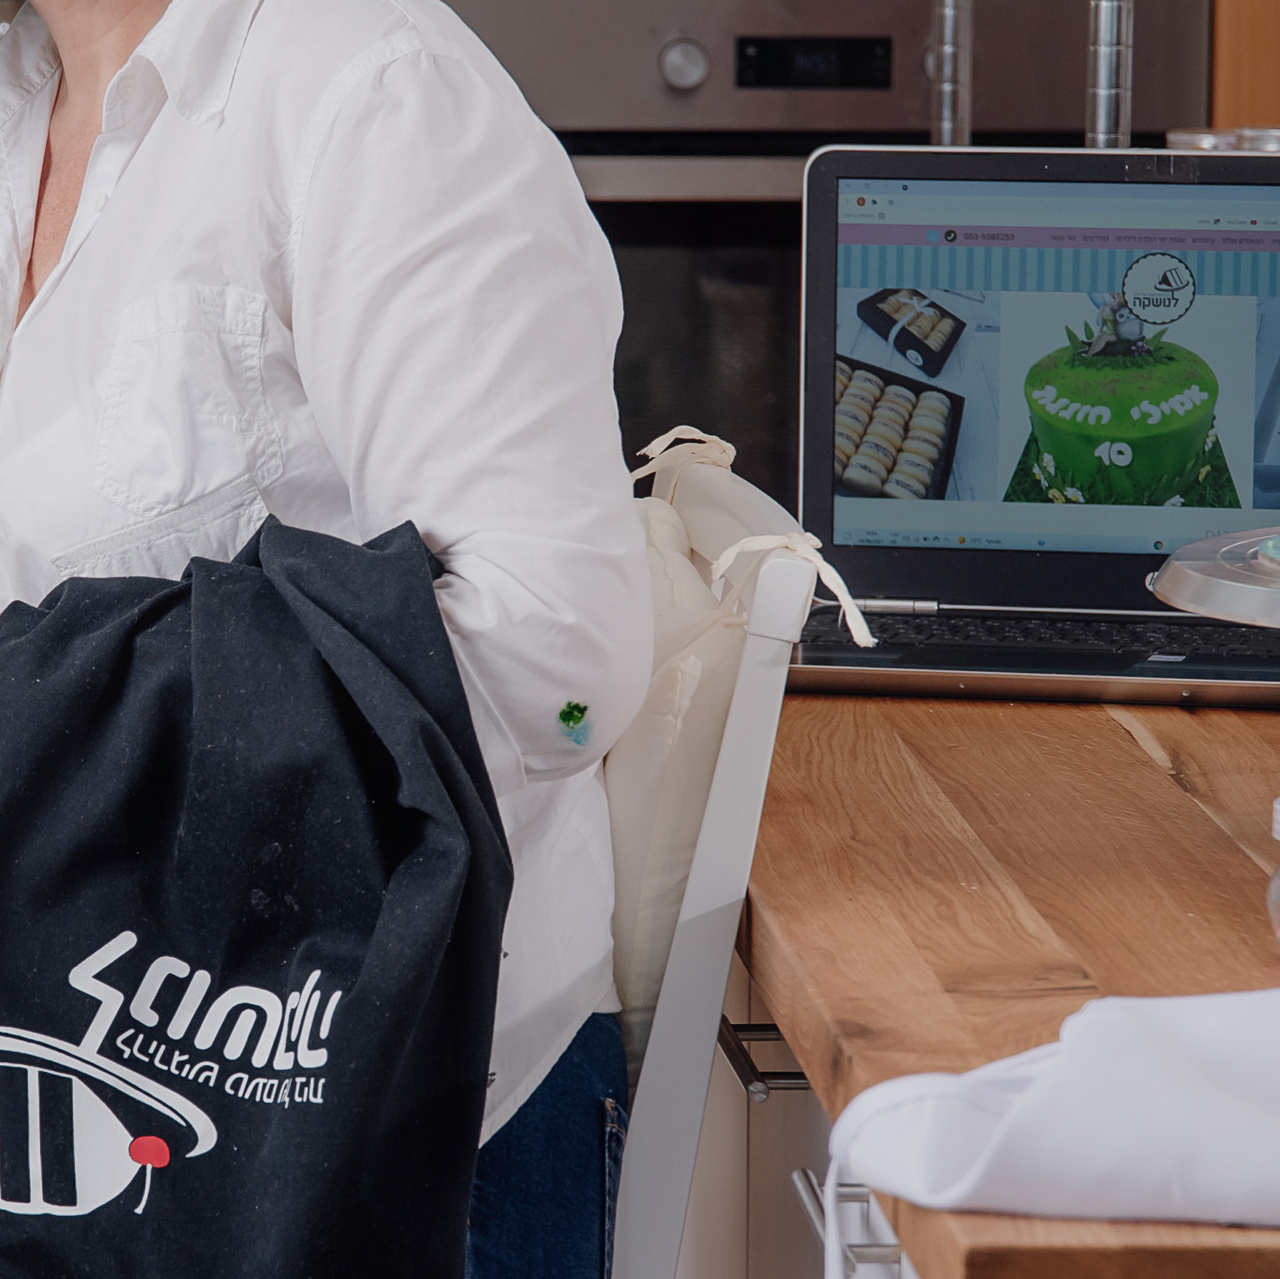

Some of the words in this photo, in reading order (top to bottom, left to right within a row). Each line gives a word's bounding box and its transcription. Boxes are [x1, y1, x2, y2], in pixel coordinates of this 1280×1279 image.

[1132, 294, 1180, 311] לנושקה
[1031, 384, 1112, 426] חוגגת
[1130, 384, 1210, 425] אמילי
[1094, 440, 1134, 468] 10
[67, 930, 343, 1071] לנושקה
[113, 1028, 220, 1087] להרגיש
[223, 1072, 280, 1104] טעם
[293, 1076, 327, 1104] בית
